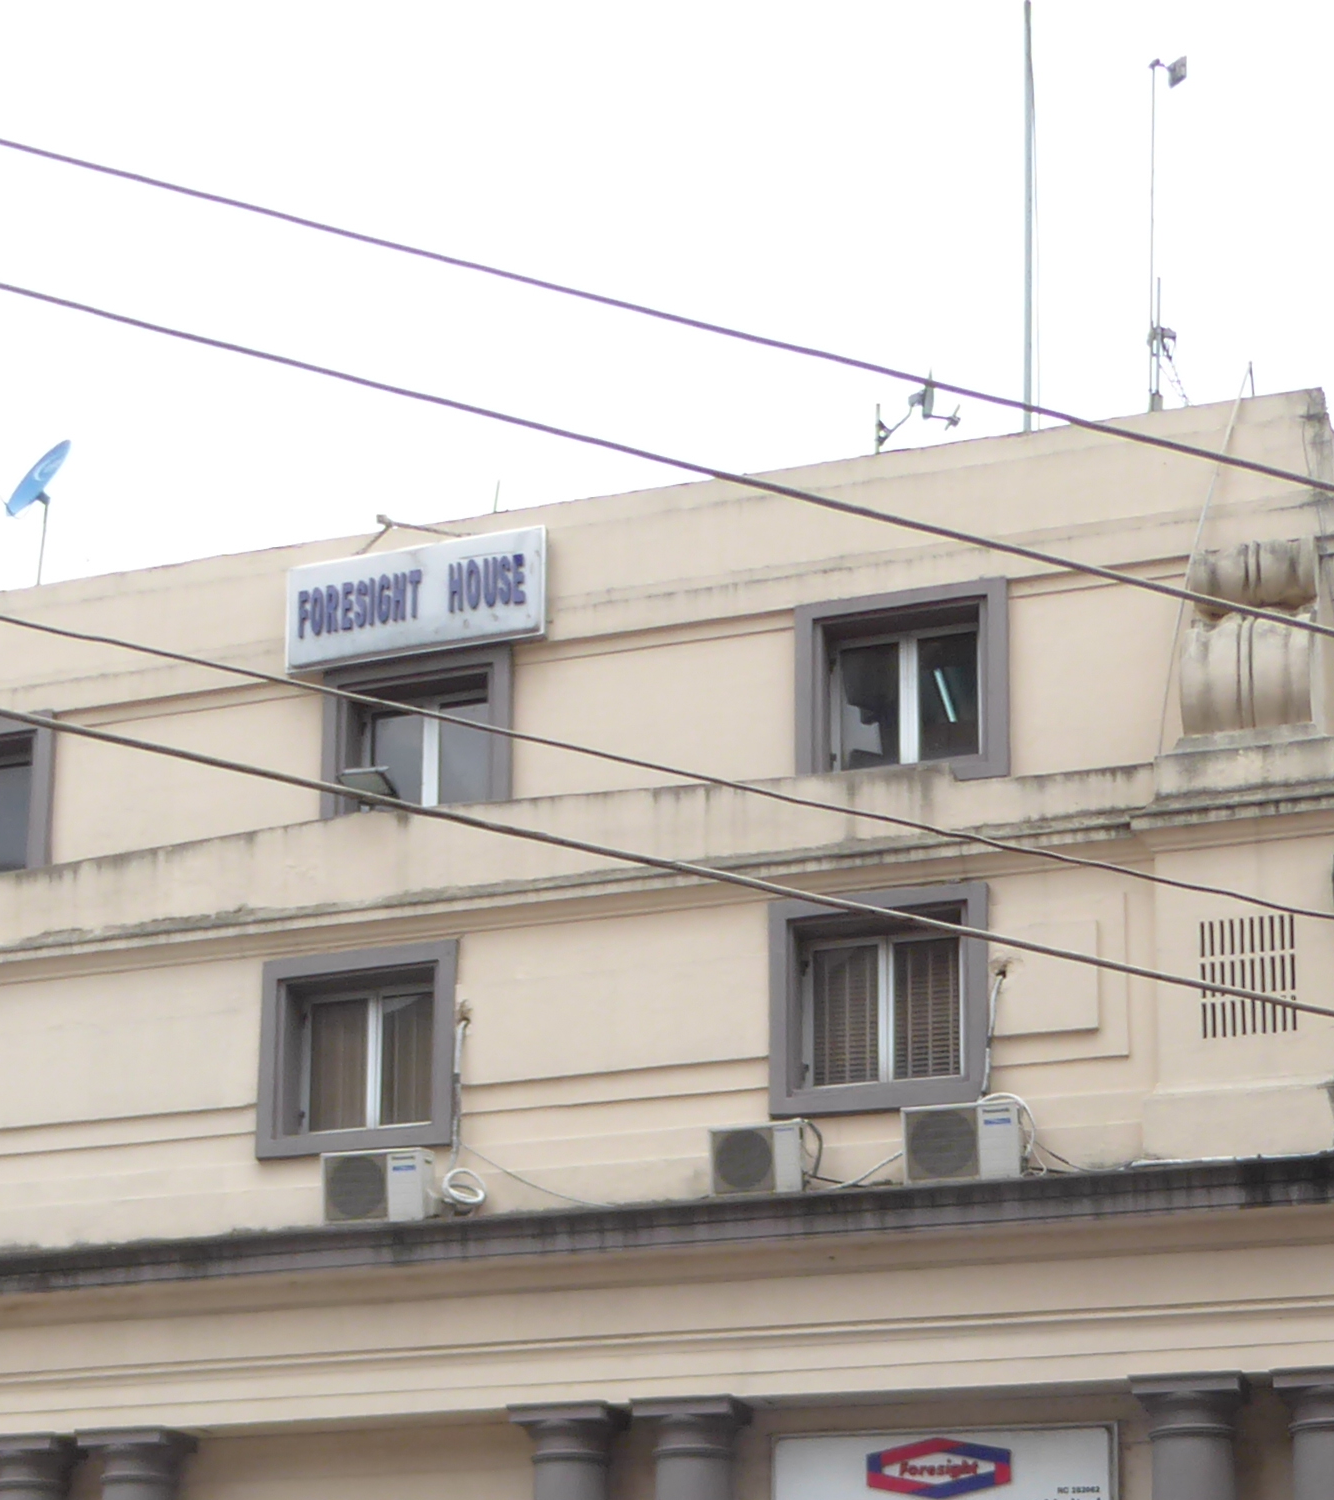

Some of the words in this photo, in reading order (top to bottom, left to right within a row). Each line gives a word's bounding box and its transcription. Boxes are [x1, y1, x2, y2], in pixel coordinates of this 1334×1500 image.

[298, 569, 423, 639] FORESIGHT
[448, 553, 526, 613] HOUSE
[899, 1458, 978, 1480] Foresight
